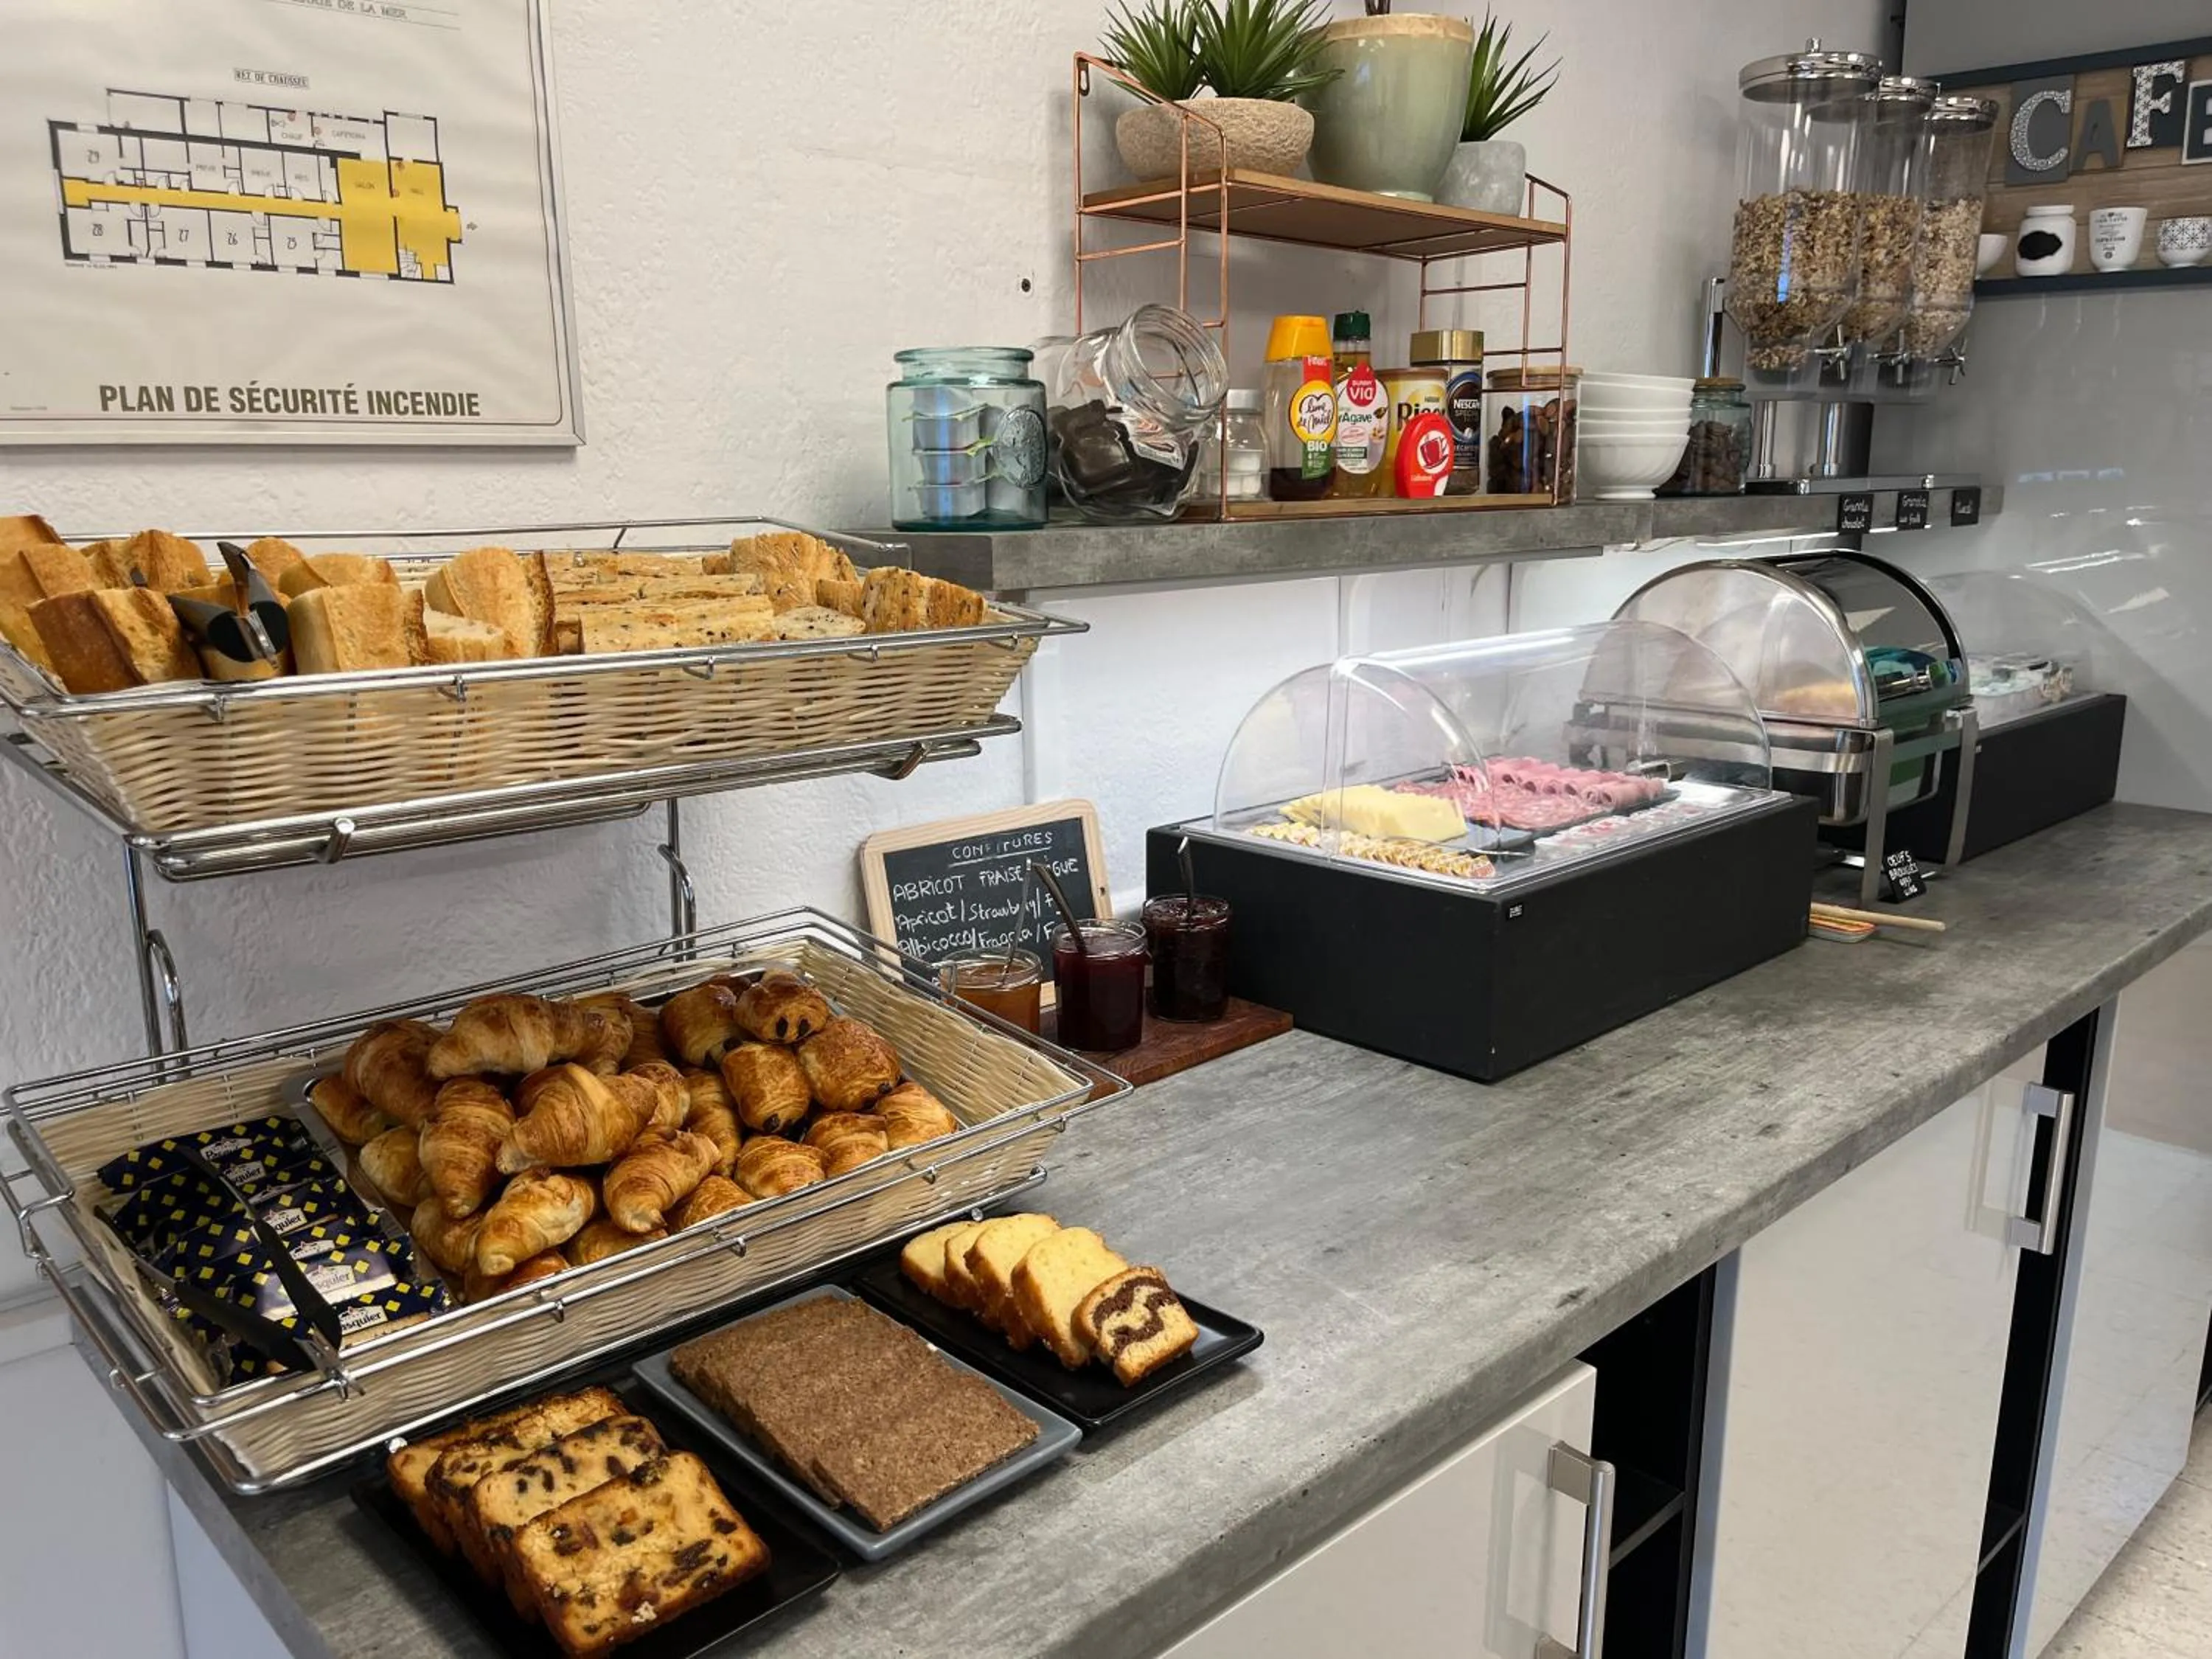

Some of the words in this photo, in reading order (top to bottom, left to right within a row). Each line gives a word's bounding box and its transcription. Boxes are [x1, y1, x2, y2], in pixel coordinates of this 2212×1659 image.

[87, 150, 100, 164] 29
[178, 229, 189, 243] 27
[227, 232, 239, 246] 26
[100, 385, 175, 413] PLAN
[184, 386, 220, 414] DE
[229, 380, 359, 414] SÉCURITÉ
[368, 389, 481, 417] INCENDIE
[1307, 439, 1328, 452] BIO
[893, 873, 966, 902] ABRICOT
[978, 864, 1024, 887] FRAISE
[341, 1312, 382, 1331] asquier
